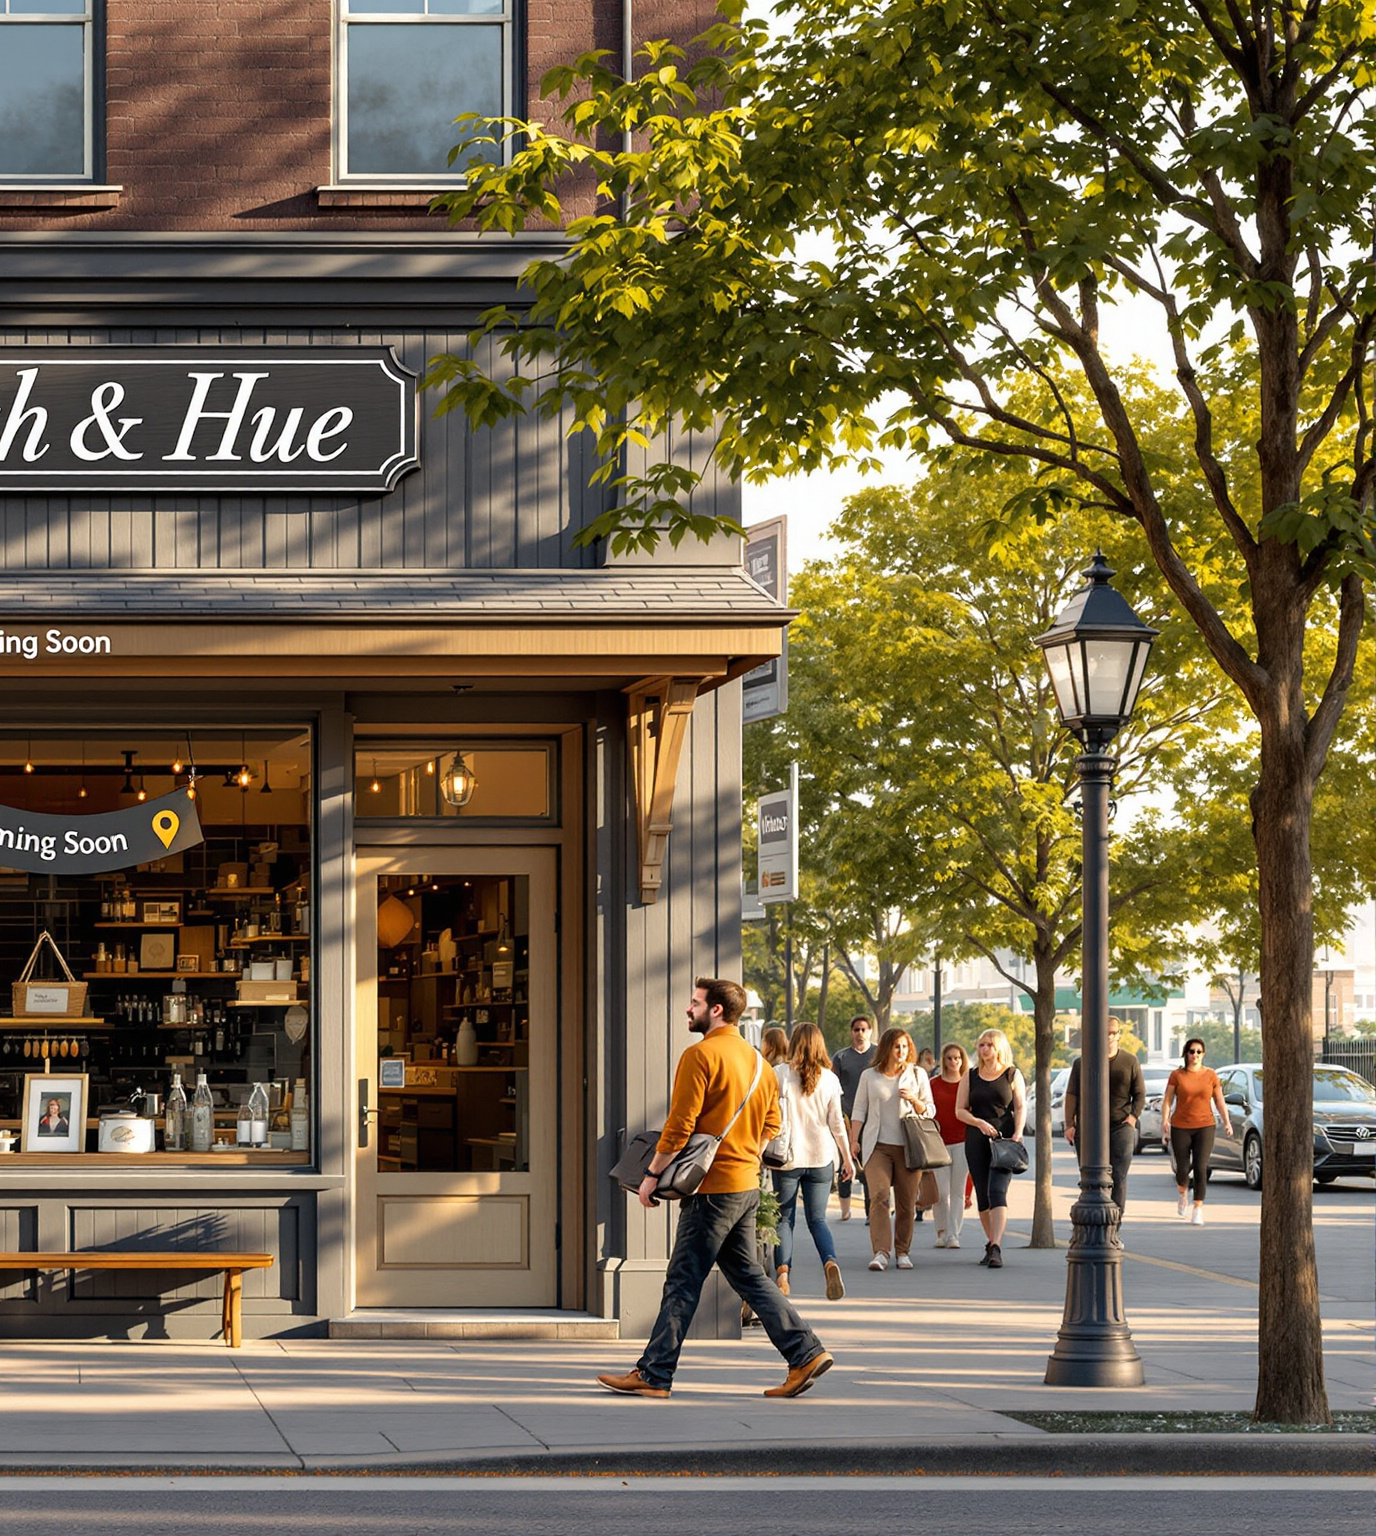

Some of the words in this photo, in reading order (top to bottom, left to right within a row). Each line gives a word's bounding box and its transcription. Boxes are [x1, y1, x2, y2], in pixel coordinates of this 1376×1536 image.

[70, 381, 144, 461] &
[161, 372, 354, 463] Hue
[45, 628, 112, 654] Soon
[63, 830, 128, 855] Soon
